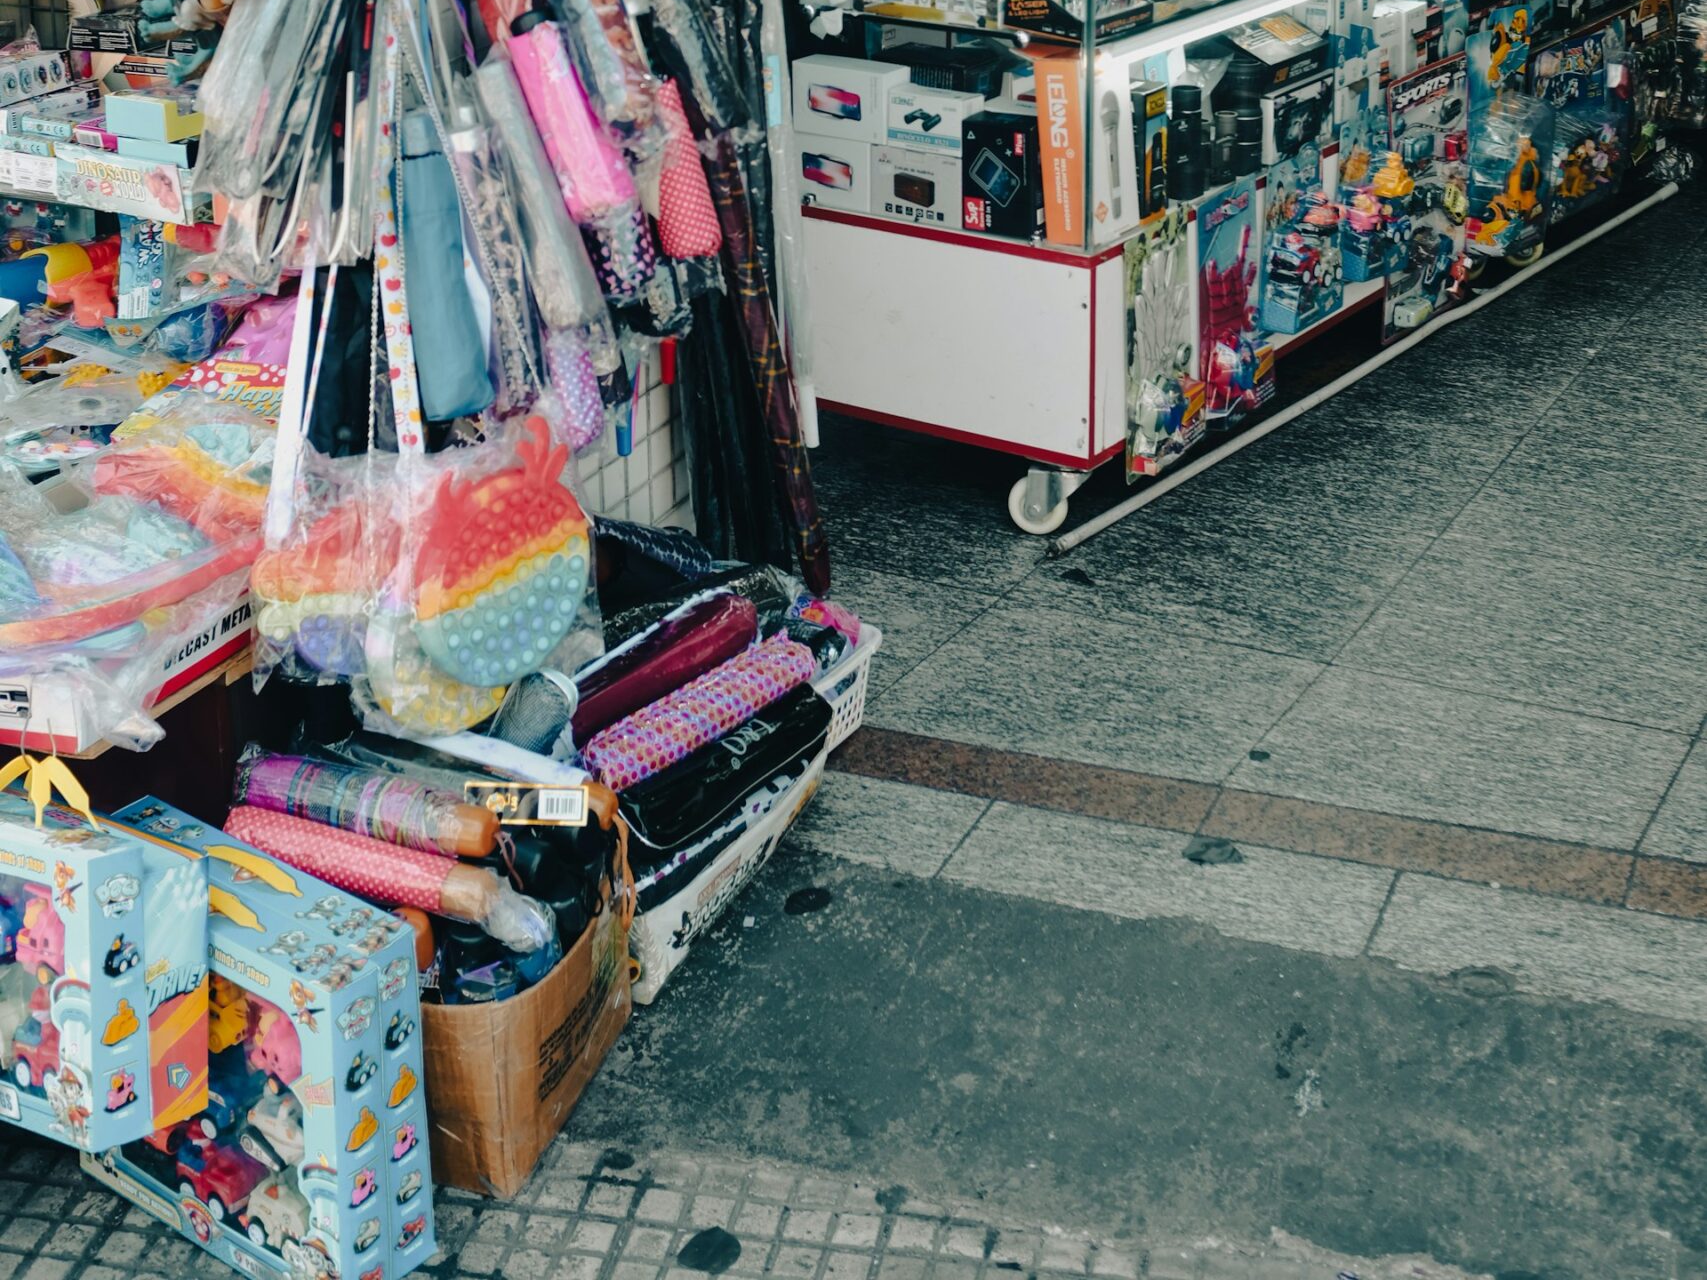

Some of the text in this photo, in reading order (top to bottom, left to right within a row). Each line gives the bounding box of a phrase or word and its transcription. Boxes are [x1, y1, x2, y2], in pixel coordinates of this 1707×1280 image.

[1395, 71, 1452, 109] SPORTS
[1015, 133, 1023, 155] Plus
[75, 158, 142, 184] DINOSAUR
[114, 180, 146, 202] WORLD
[964, 201, 979, 225] Sup
